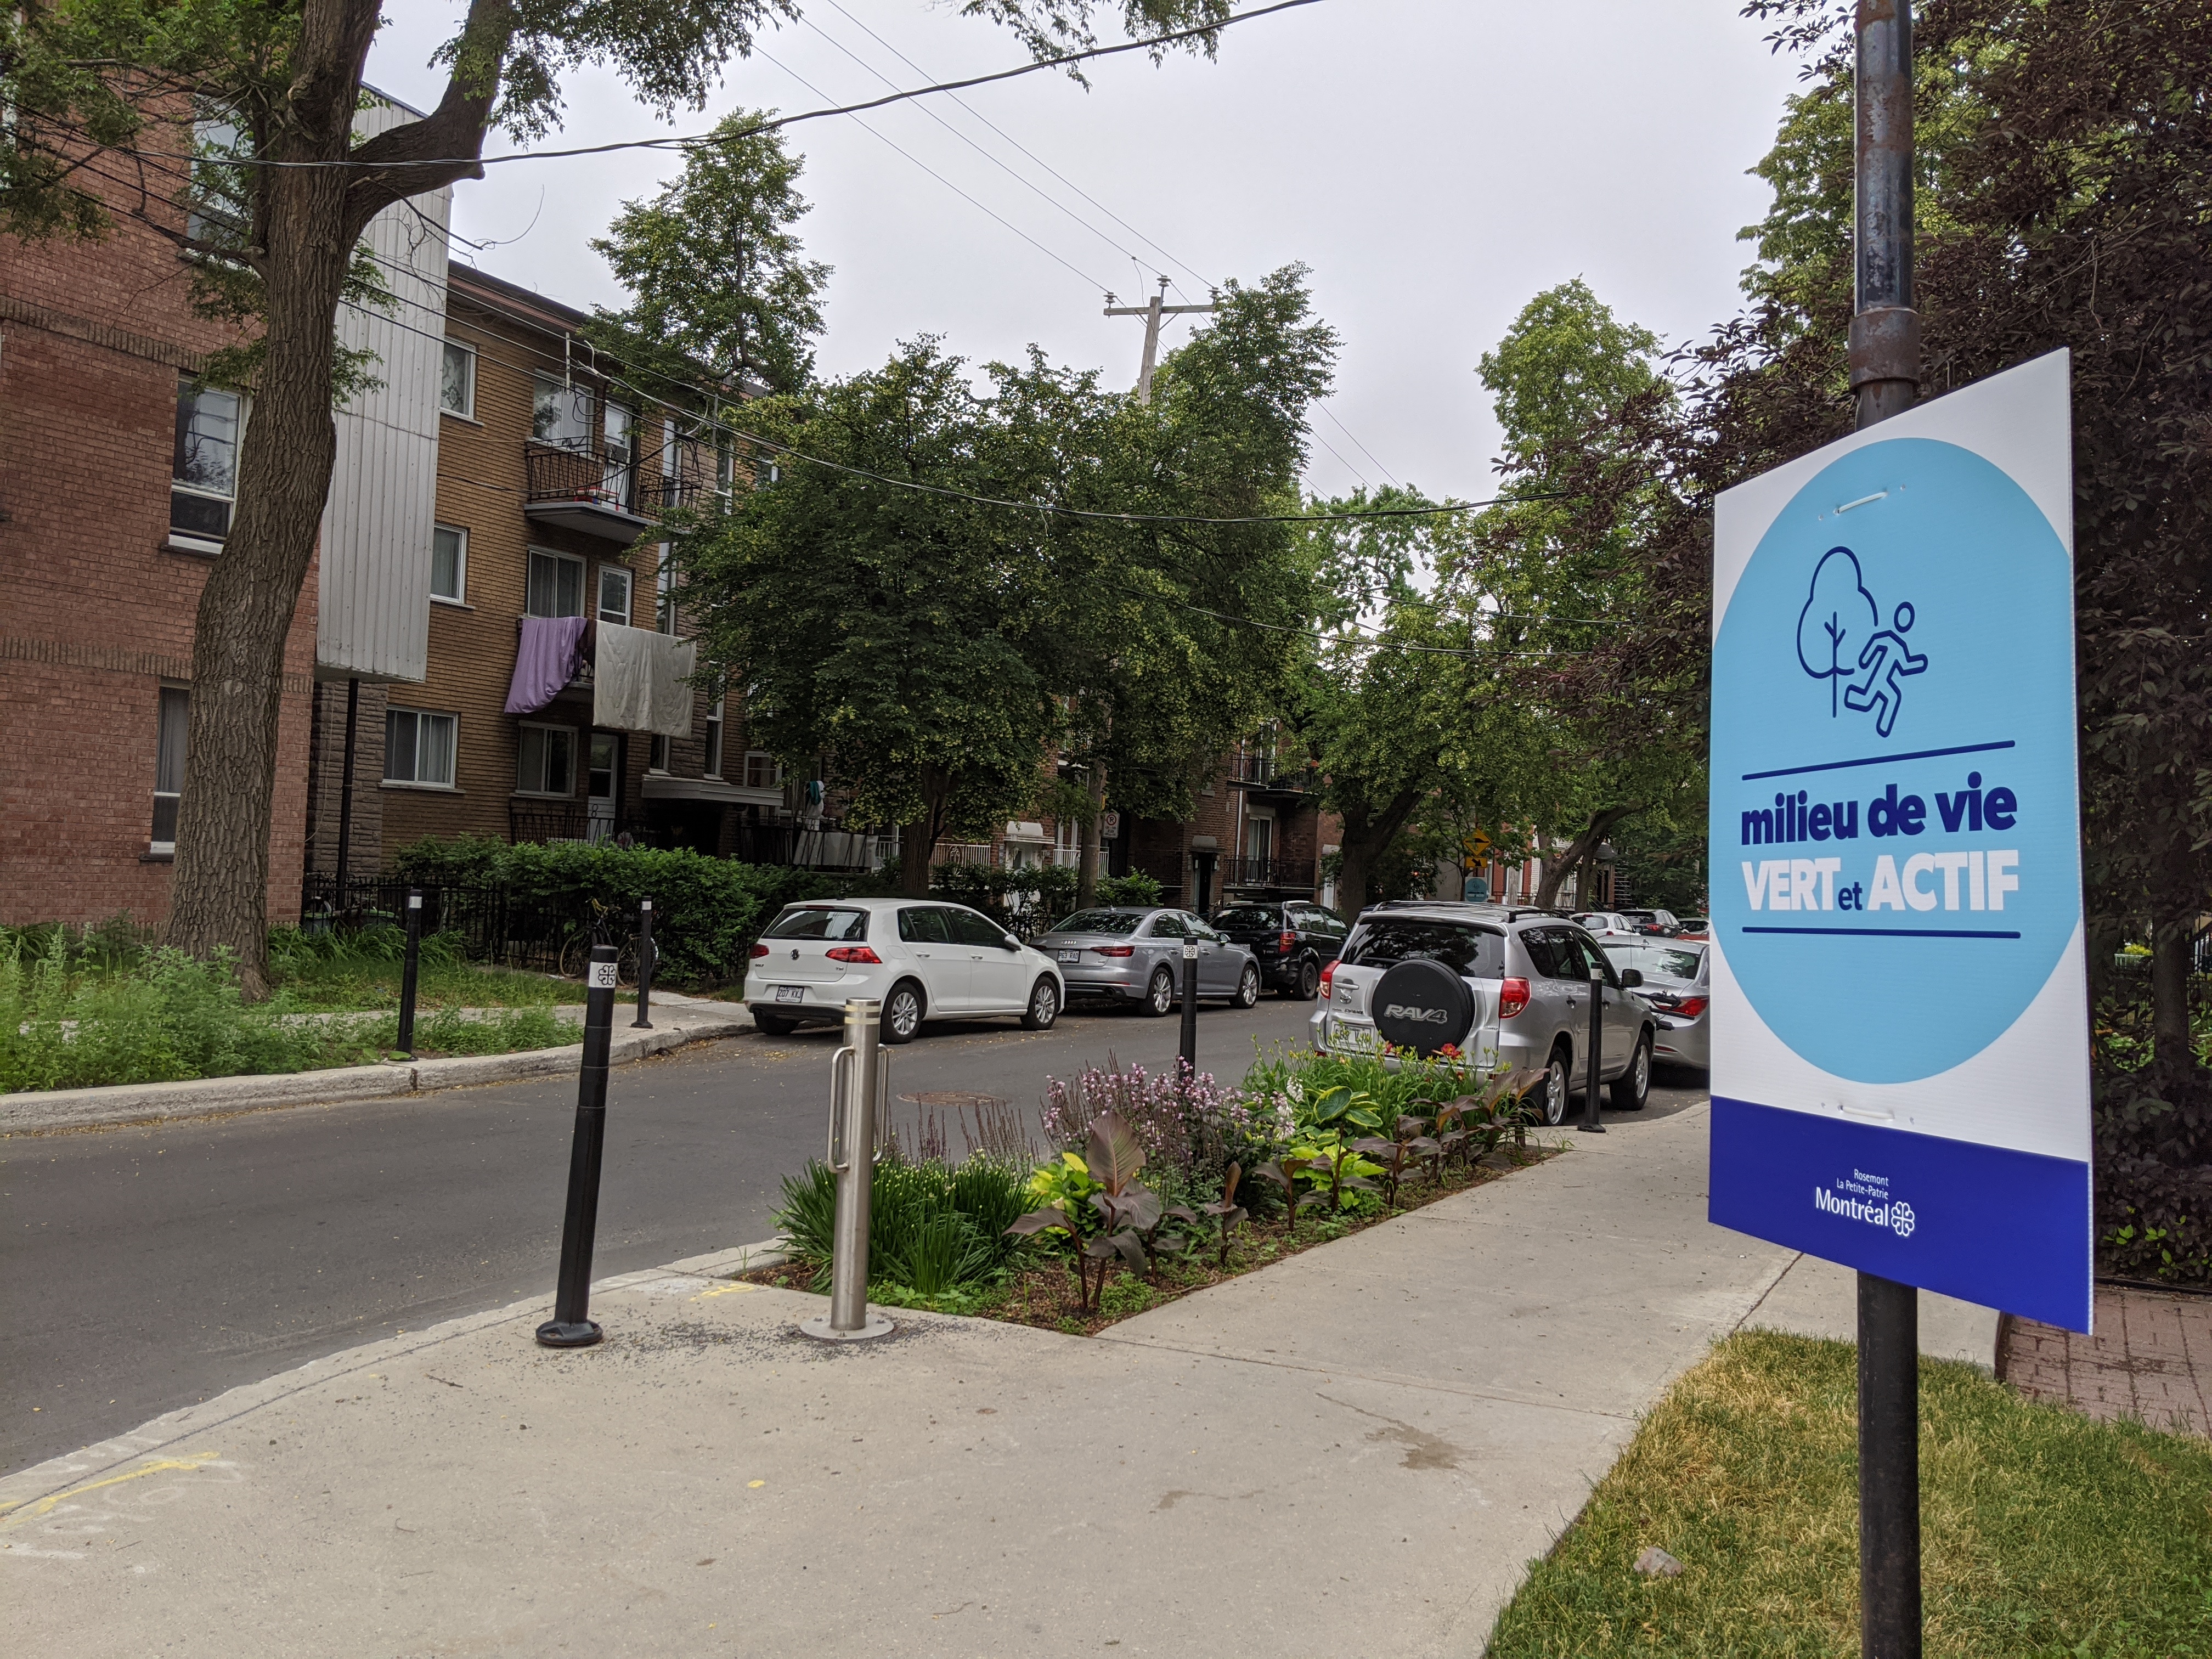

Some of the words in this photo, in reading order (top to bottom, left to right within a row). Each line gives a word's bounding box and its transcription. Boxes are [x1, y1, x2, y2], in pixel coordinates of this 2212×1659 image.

[1741, 790, 1858, 845] milieu
[1867, 783, 1926, 838] de
[1934, 771, 2017, 833] vie
[1741, 857, 1841, 911] VERT
[1838, 882, 1863, 911] et
[1866, 849, 2019, 911] ACTIF
[778, 989, 789, 997] Z07
[791, 990, 803, 998] KXJ
[1384, 1003, 1448, 1024] RAV4
[1836, 1177, 1844, 1189] La
[1846, 1180, 1889, 1200] Petite-Patrie
[1854, 1168, 1889, 1187] Rosemont
[1815, 1186, 1889, 1227] Montréal
